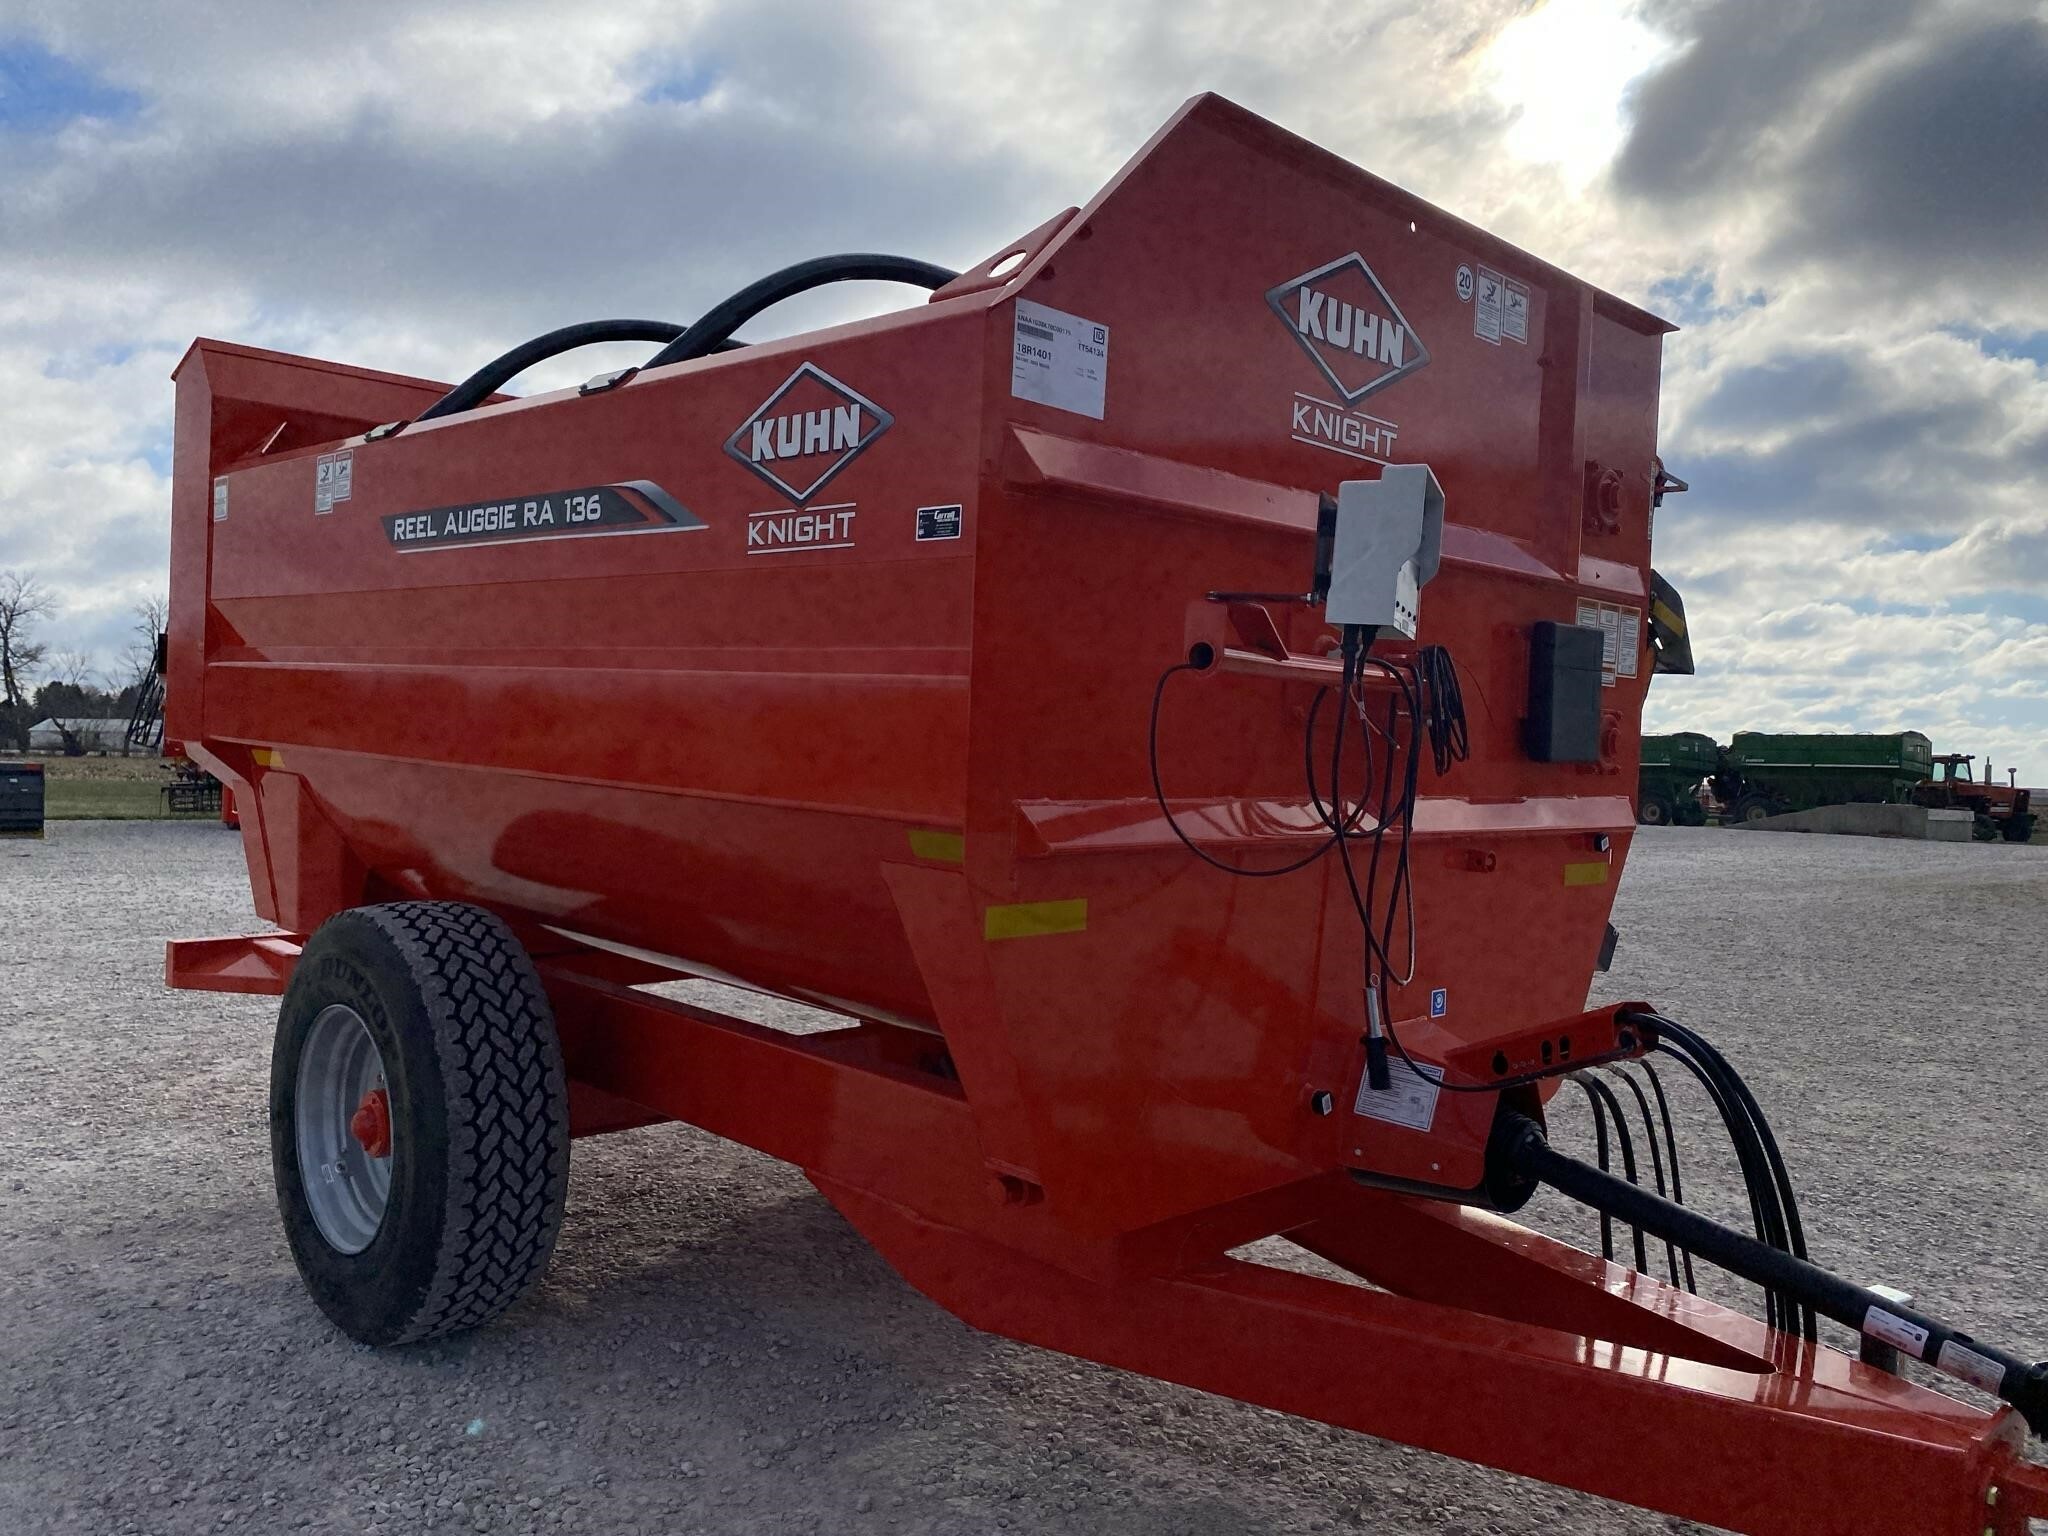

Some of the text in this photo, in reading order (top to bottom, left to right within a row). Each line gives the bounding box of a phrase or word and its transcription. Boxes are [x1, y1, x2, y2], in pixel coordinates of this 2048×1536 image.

[1459, 272, 1471, 290] 20
[1298, 286, 1405, 369] KUHN
[1016, 343, 1052, 361] 18R1401
[751, 403, 861, 463] KUHN
[1292, 401, 1399, 457] KNIGHT
[394, 494, 601, 541] REEL AUGGIE RA 136
[747, 511, 856, 546] KNIGHT
